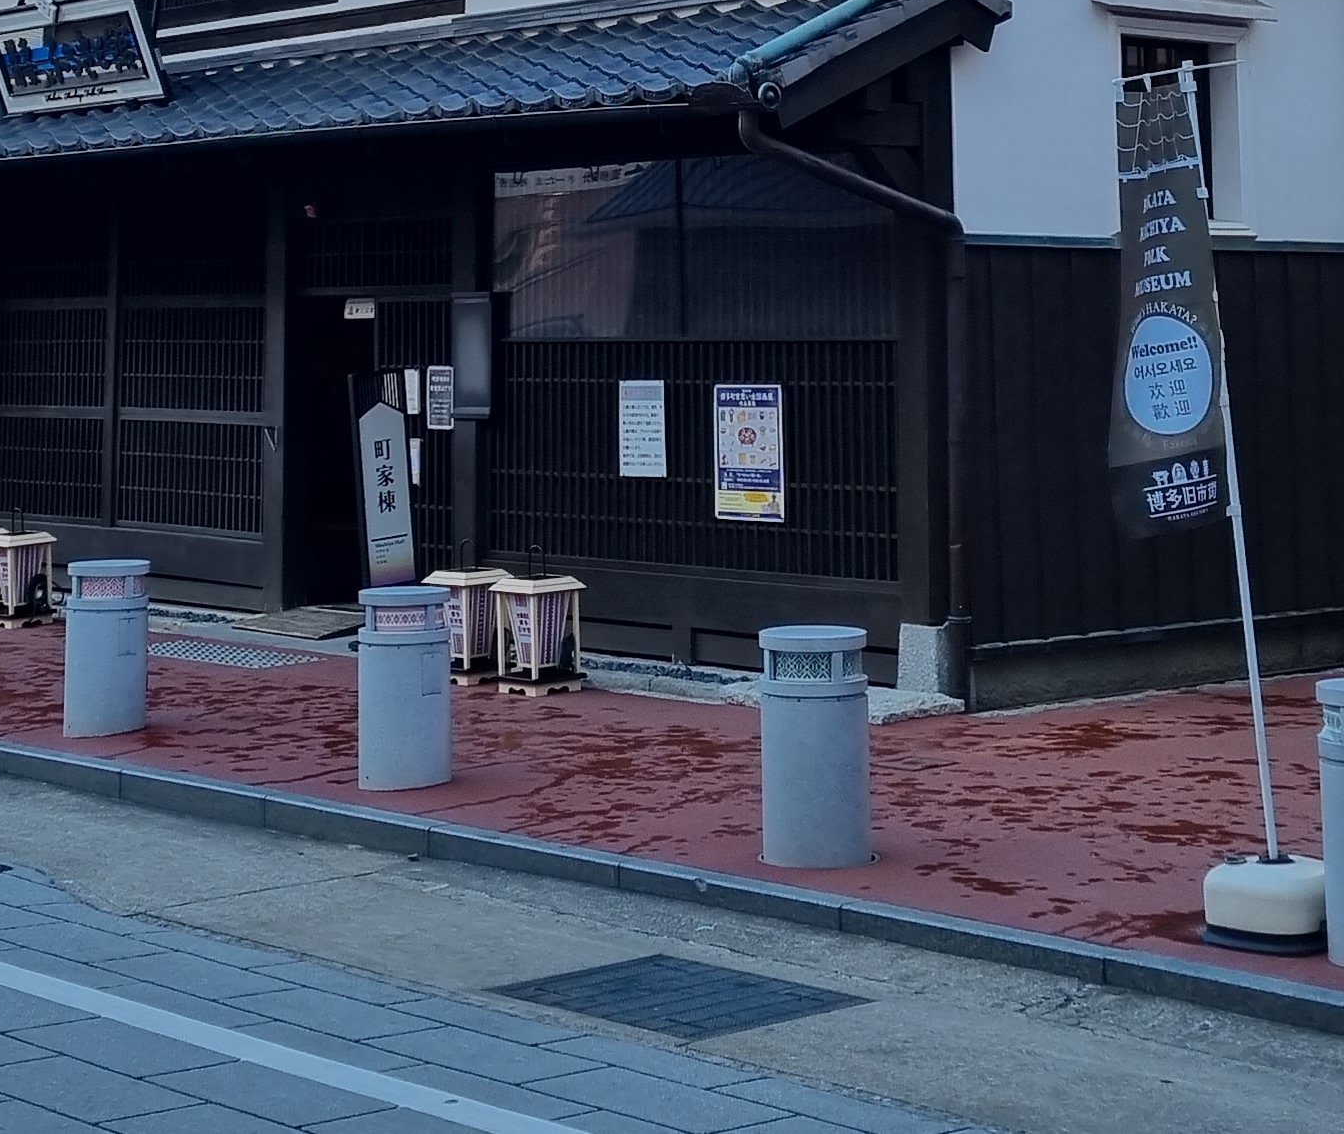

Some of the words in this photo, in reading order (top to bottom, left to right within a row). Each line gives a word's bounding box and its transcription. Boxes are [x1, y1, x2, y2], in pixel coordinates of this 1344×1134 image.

[1131, 335, 1199, 360] Welcome!!
[1134, 357, 1198, 380] 어서오세요
[374, 439, 397, 514] 町家棟
